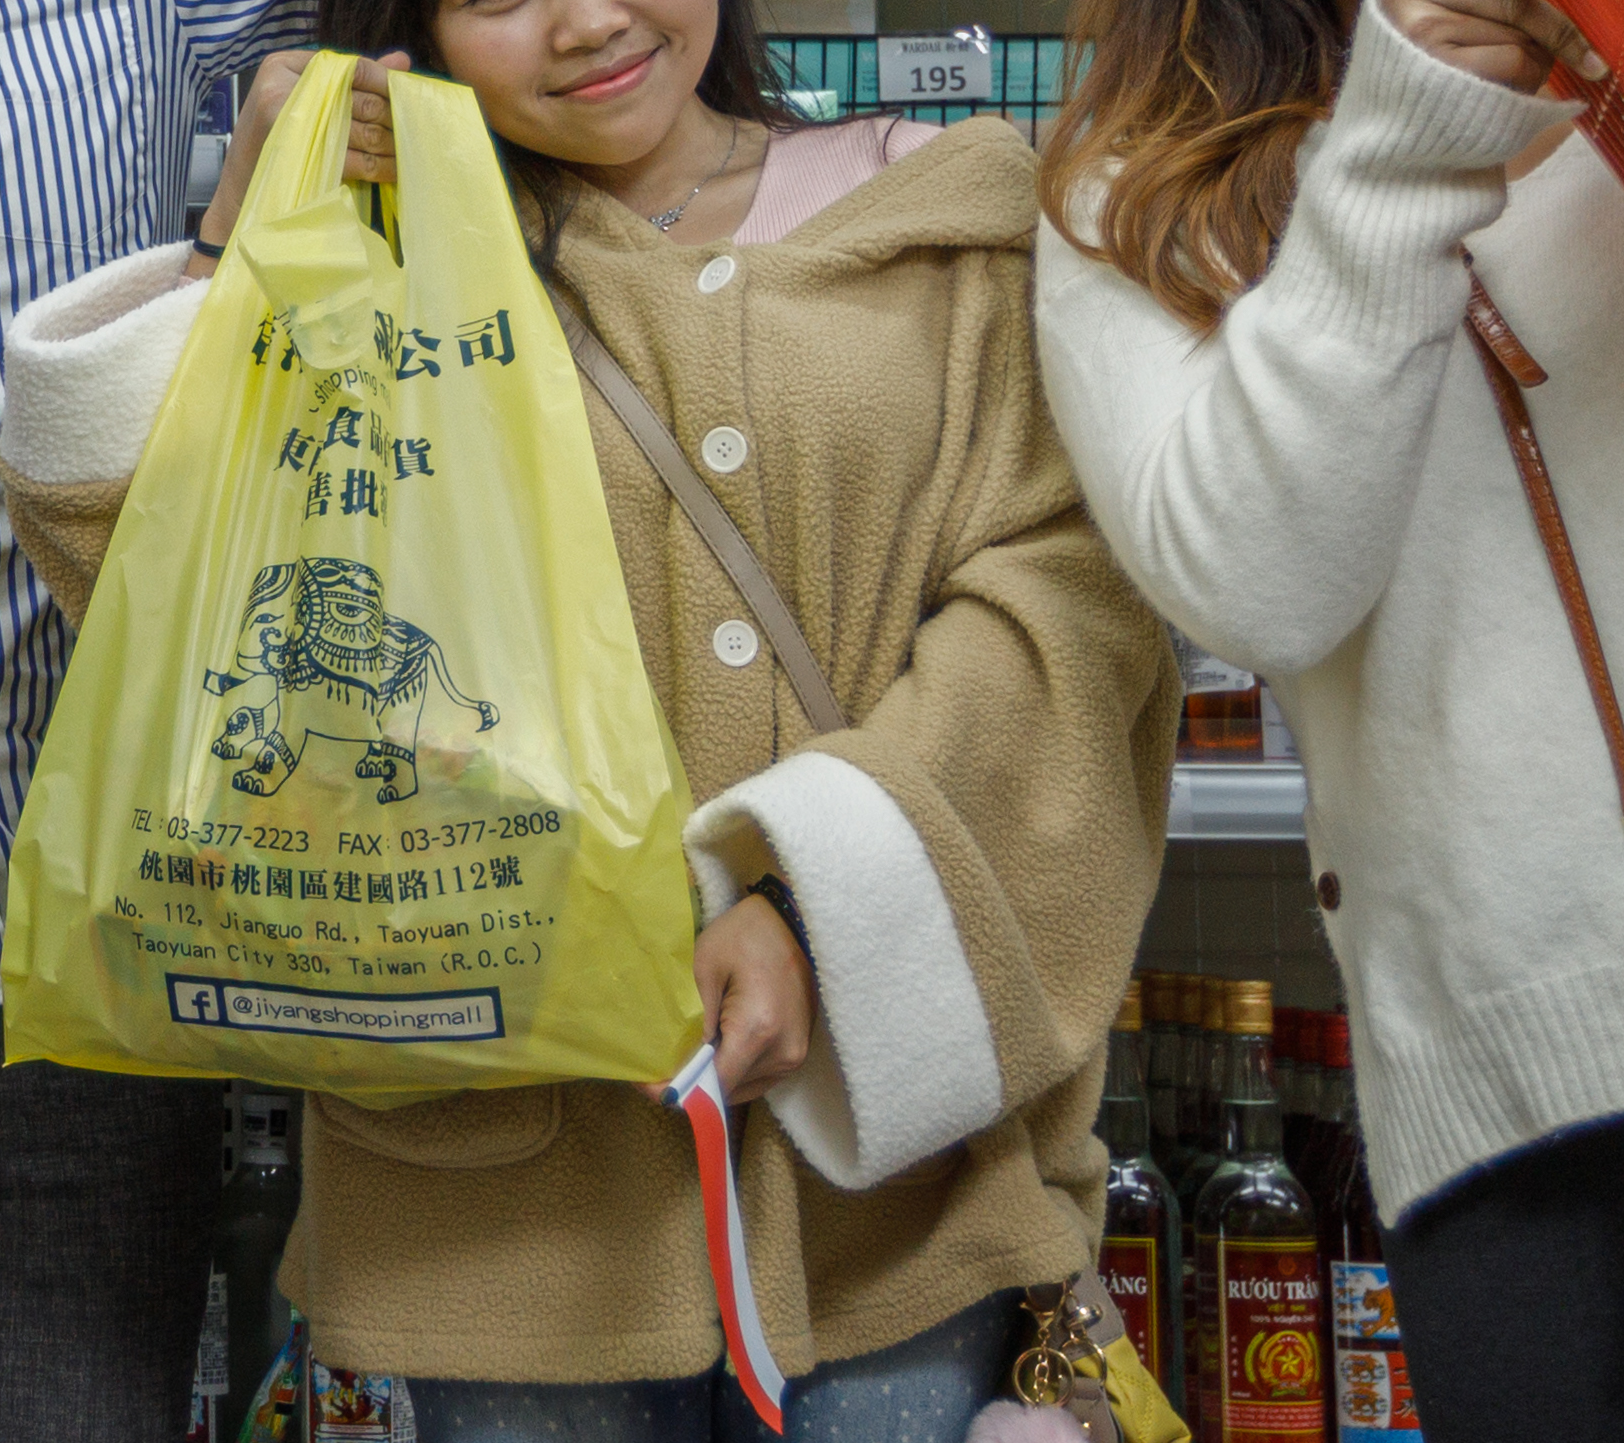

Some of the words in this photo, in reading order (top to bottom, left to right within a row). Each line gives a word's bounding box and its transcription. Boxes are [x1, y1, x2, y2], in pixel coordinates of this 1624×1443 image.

[909, 66, 968, 96] 195
[167, 816, 310, 853] 03-377-2223
[400, 810, 561, 854] 03-377-2808
[138, 848, 524, 906] 桃園市桃園區建國路112號
[114, 895, 145, 920] No.
[219, 912, 303, 943] Jianguo
[377, 918, 470, 945] Taoyuan
[132, 932, 217, 959] Taoyuan
[227, 944, 275, 970] City
[287, 954, 331, 975] 330,
[347, 956, 426, 977] Taiwan
[440, 941, 542, 975] (R.O.C.)
[232, 995, 483, 1030] @jiyangshoppingmall
